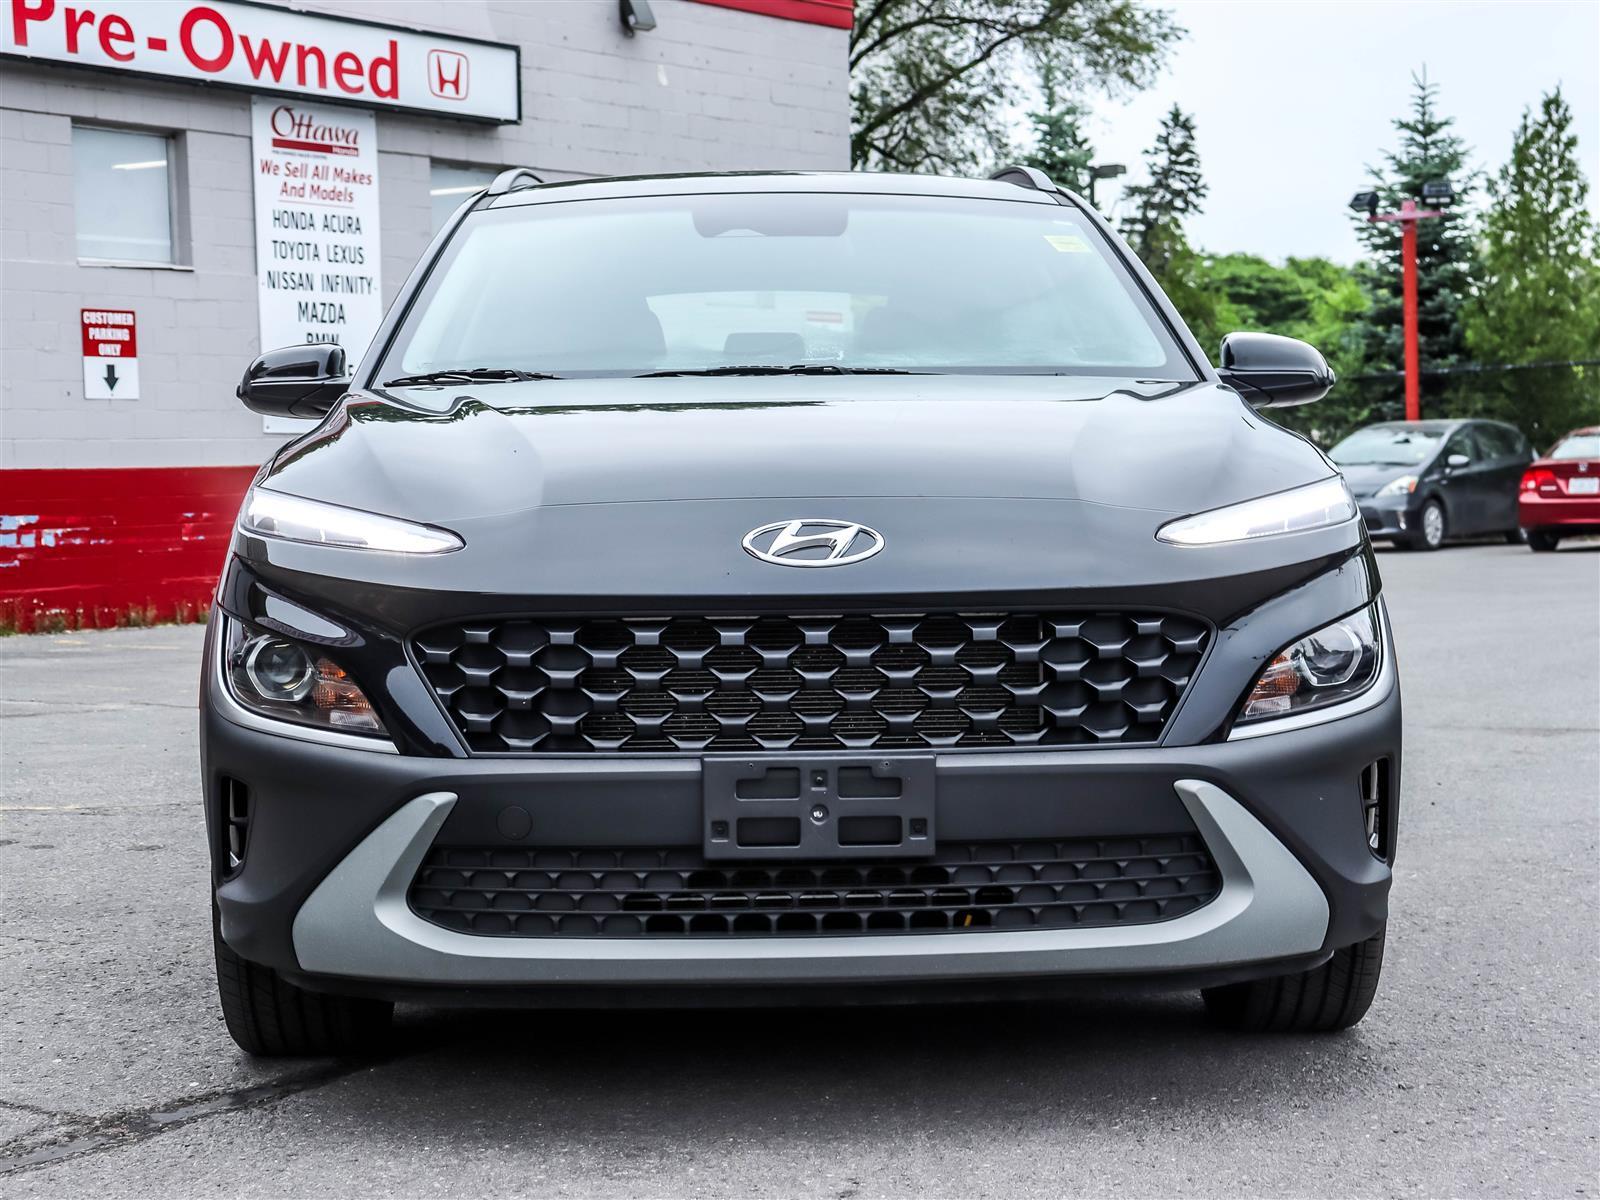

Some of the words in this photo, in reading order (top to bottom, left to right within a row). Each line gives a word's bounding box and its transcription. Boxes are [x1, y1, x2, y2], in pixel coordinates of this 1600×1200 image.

[11, 0, 399, 99] Pre-Owned
[271, 105, 359, 145] Ottawa
[260, 159, 280, 175] We
[284, 161, 308, 178] Sell
[311, 165, 329, 181] All
[333, 167, 373, 185] Makes
[280, 181, 305, 198] And
[309, 184, 354, 203] Models
[272, 209, 316, 230] HONDA
[322, 213, 362, 235] ACURA
[272, 240, 320, 261] TOYOTA
[326, 244, 365, 264] LEXUS
[267, 270, 314, 291] NISSAN
[321, 274, 373, 295] INFINITY
[83, 311, 134, 325] CUSTOMER
[298, 301, 346, 324] MAZDA
[88, 327, 130, 341] PARKING
[98, 343, 121, 356] ONLY
